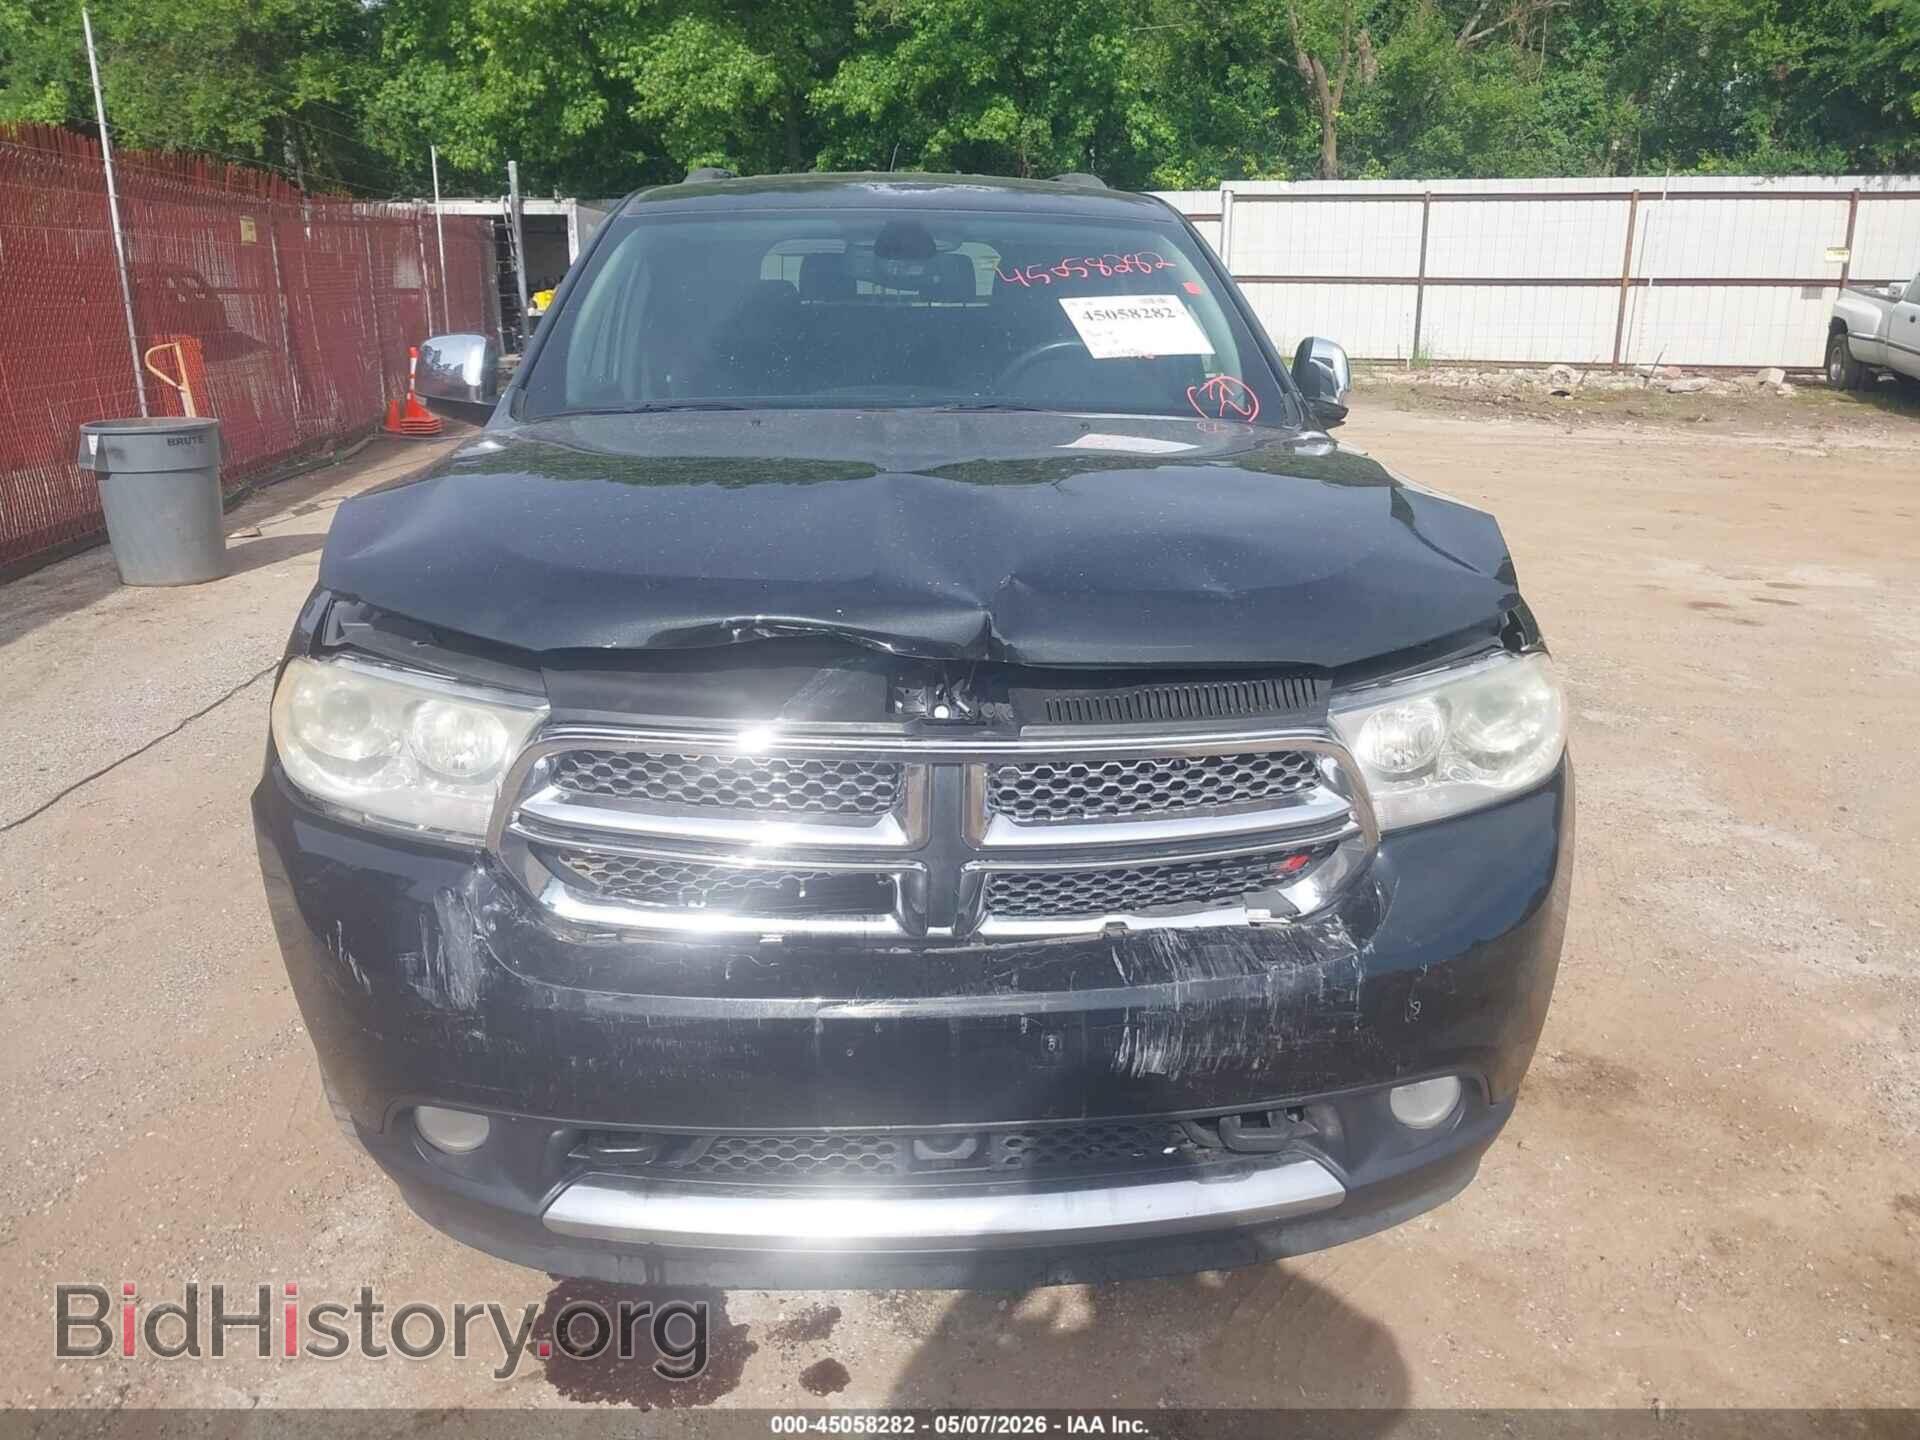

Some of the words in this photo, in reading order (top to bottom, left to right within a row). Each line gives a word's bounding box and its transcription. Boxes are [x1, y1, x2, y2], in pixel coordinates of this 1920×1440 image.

[996, 251, 1176, 287] 45058282
[1083, 307, 1177, 321] 45058282
[167, 435, 206, 447] BRUTE
